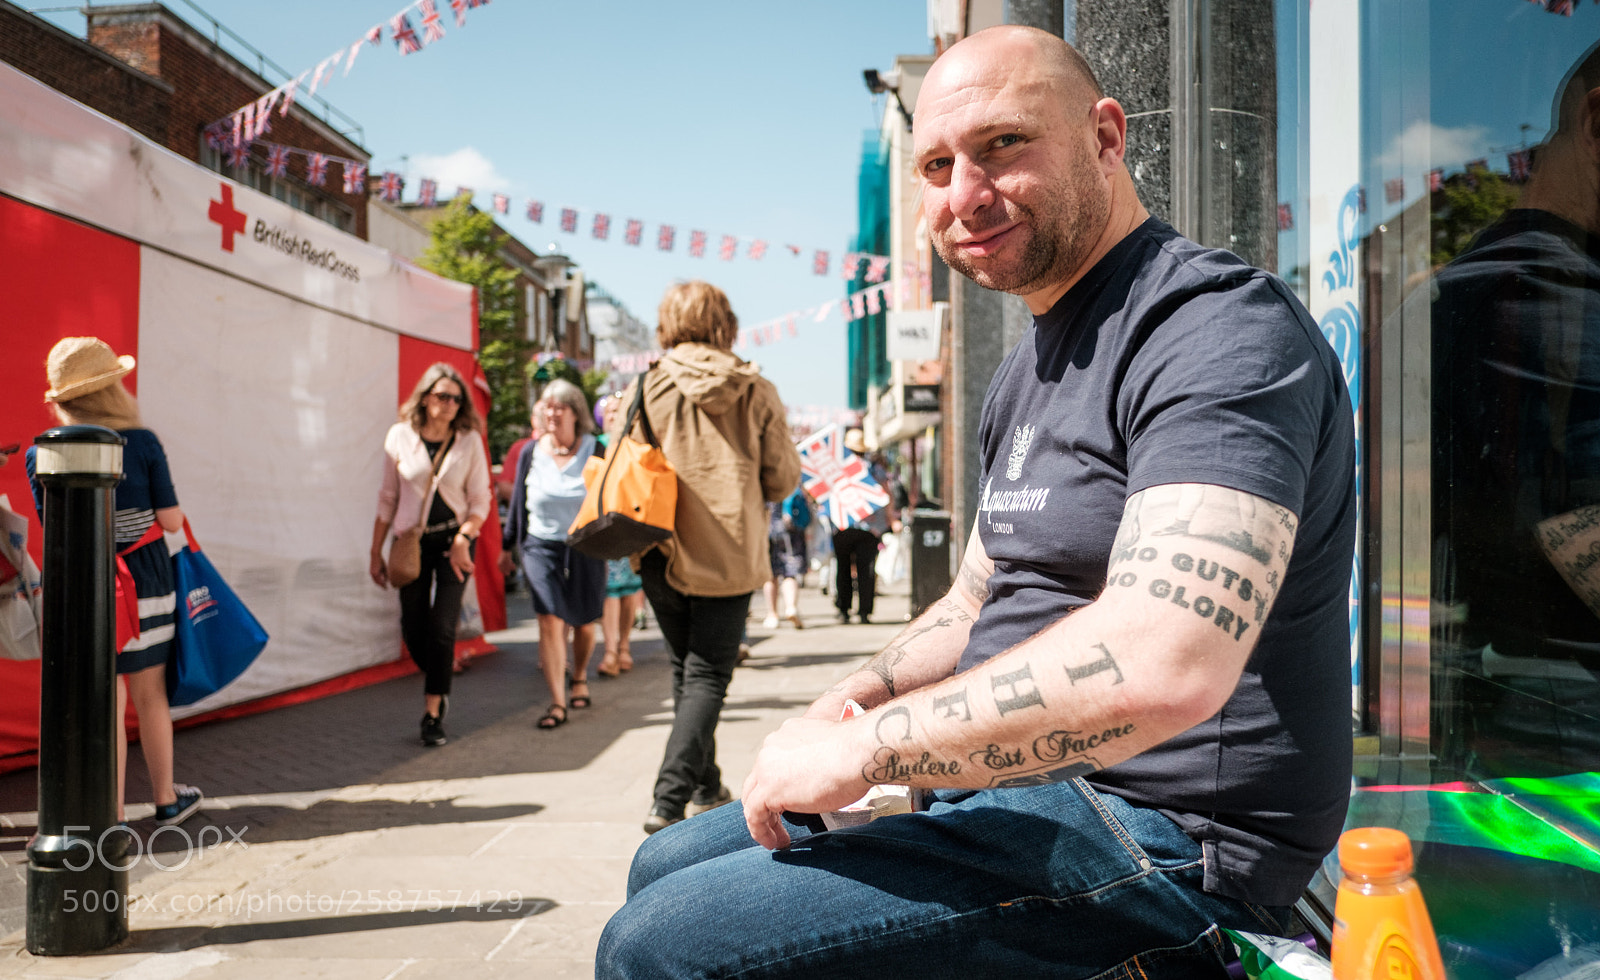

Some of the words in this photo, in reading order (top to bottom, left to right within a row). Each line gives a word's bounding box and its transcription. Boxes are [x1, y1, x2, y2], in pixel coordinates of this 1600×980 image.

[992, 522, 1014, 535] LONDON
[1117, 546, 1158, 563] NO
[1171, 552, 1253, 602] GUTS
[1148, 578, 1250, 642] GLORY
[862, 747, 961, 785] Audere
[969, 743, 1026, 770] Est
[1032, 723, 1138, 762] Facere
